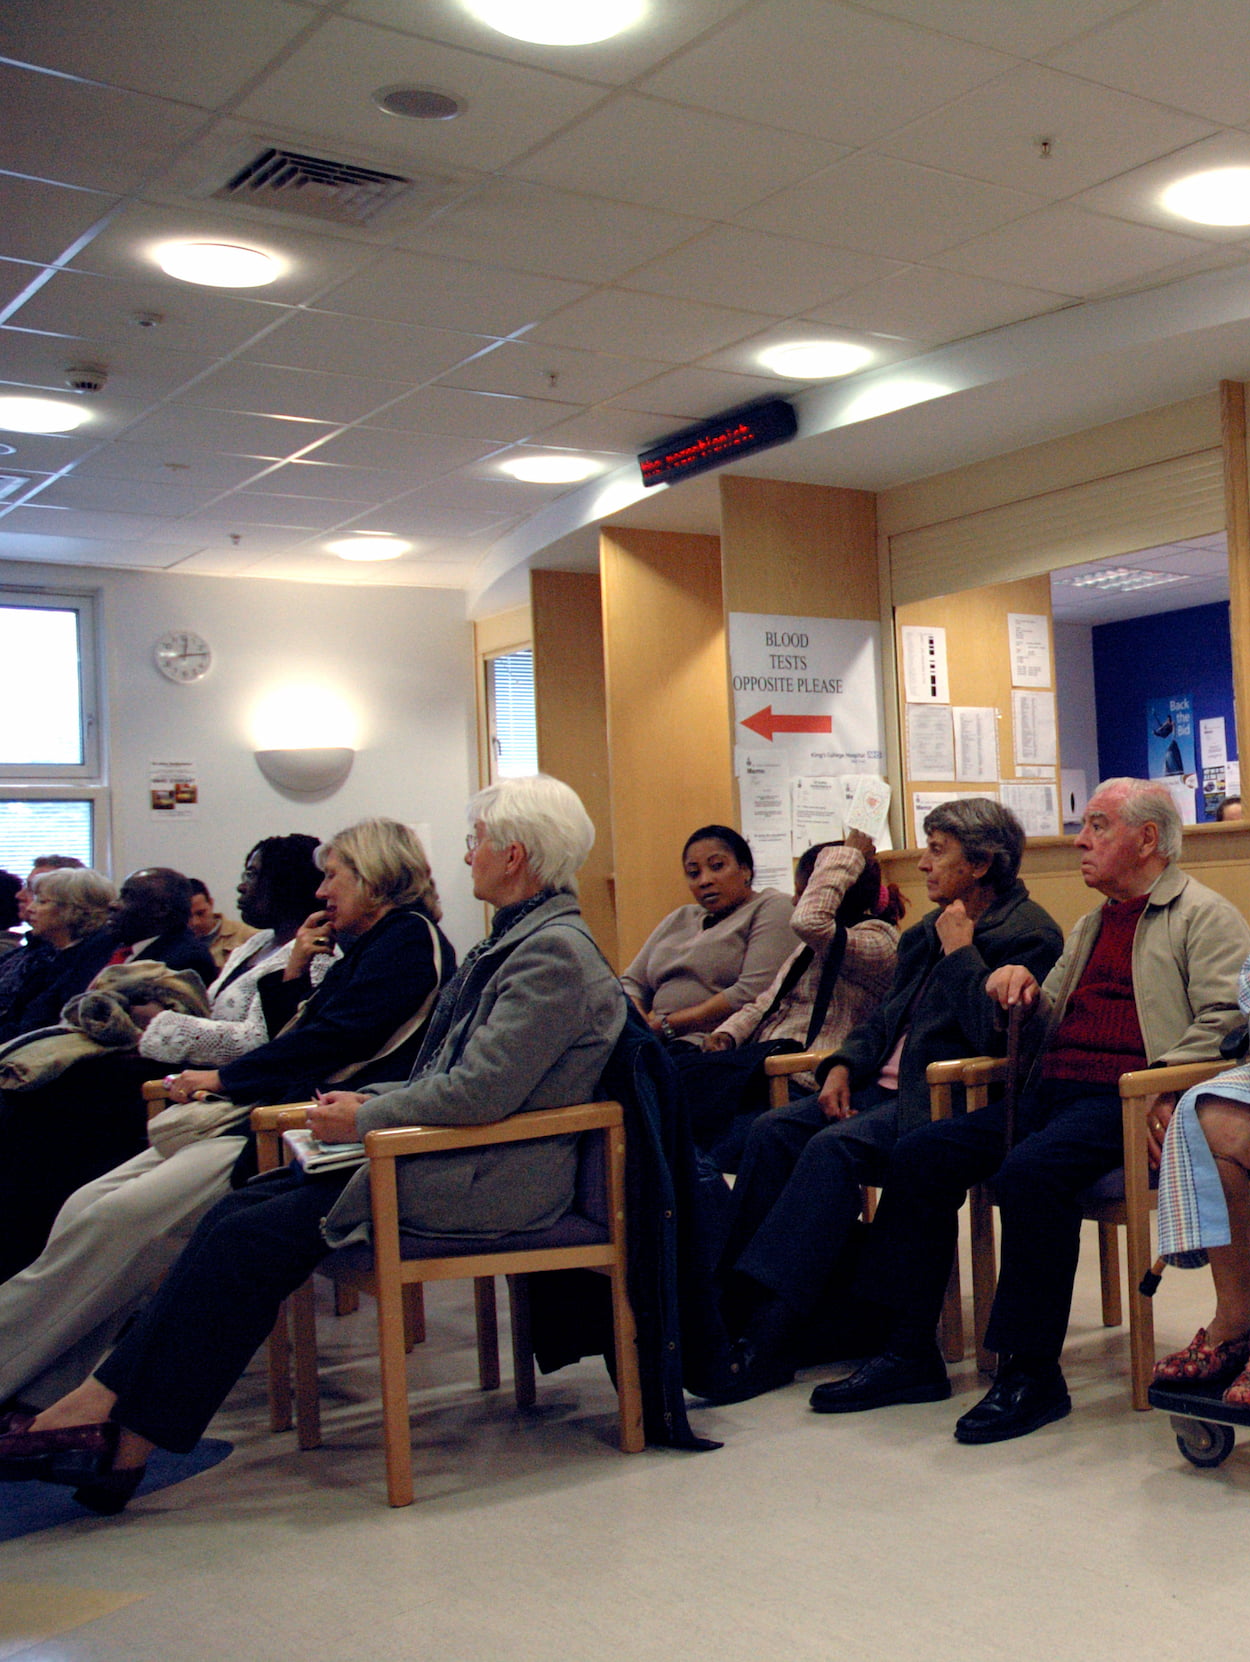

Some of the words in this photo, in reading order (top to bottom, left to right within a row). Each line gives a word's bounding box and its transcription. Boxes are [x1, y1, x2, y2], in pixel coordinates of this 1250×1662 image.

[765, 631, 809, 648] BLOOD
[769, 654, 808, 671] TESTS
[733, 675, 794, 692] OPPOSITE
[797, 678, 844, 694] PLEASE
[1169, 699, 1190, 711] Back
[1176, 712, 1191, 724] the
[1177, 725, 1191, 736] Bid
